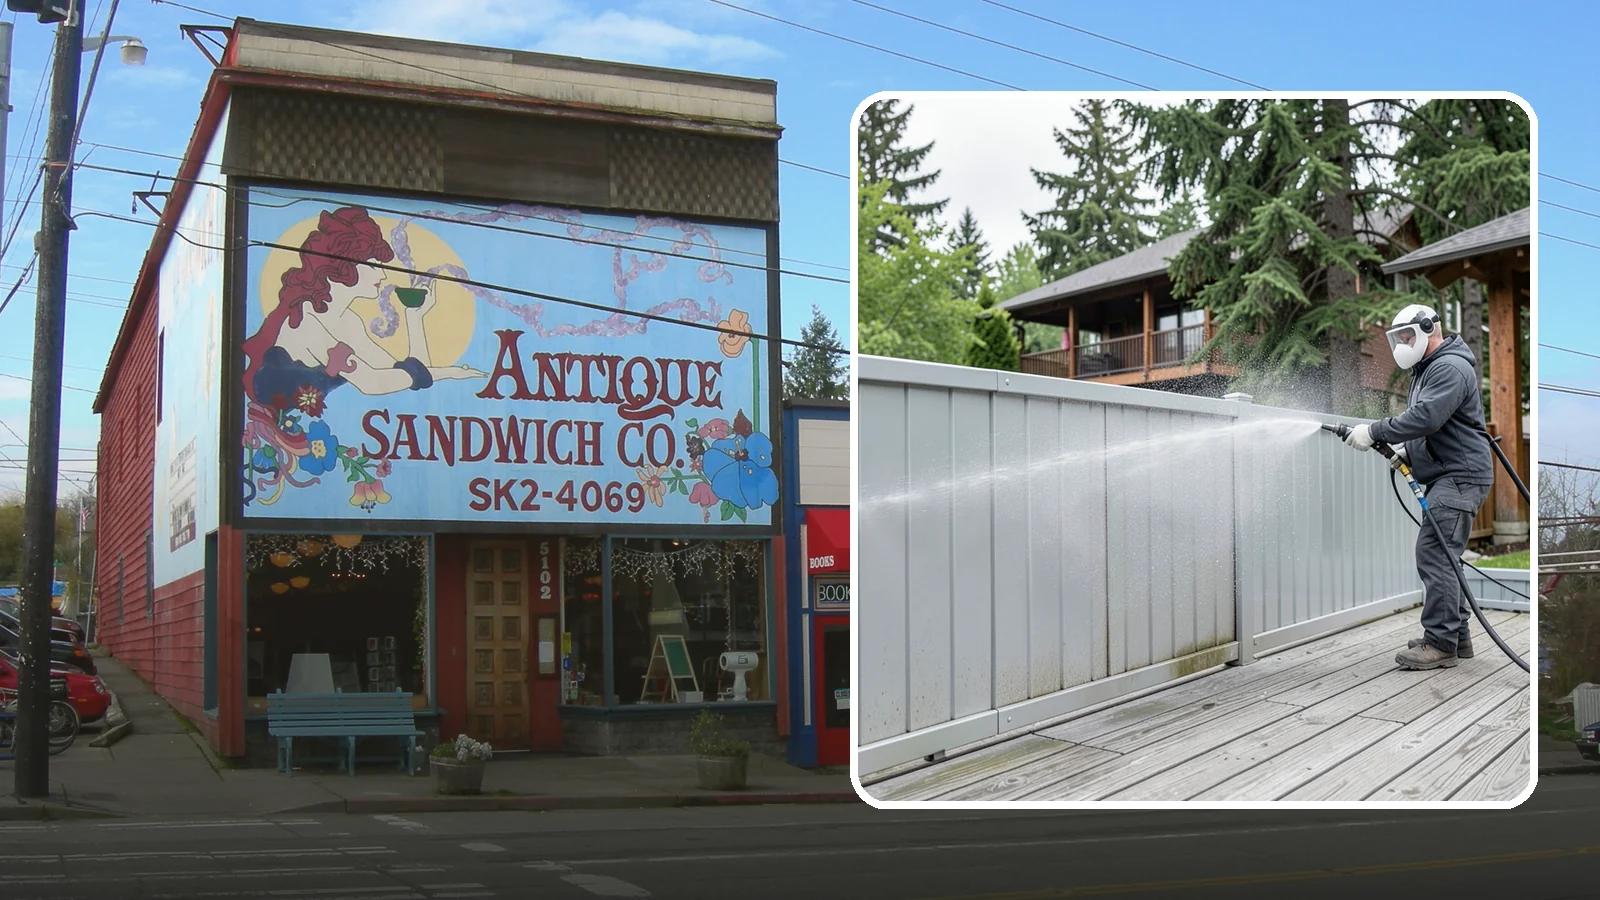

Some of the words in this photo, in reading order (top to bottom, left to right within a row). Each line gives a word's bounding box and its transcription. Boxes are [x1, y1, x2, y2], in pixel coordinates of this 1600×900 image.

[476, 329, 723, 420] ANTIQUE
[361, 408, 604, 467] SANDWICH
[617, 421, 684, 469] CO.
[469, 478, 646, 512] SK2-4069
[539, 542, 552, 600] 5102
[809, 555, 835, 569] BOOKS
